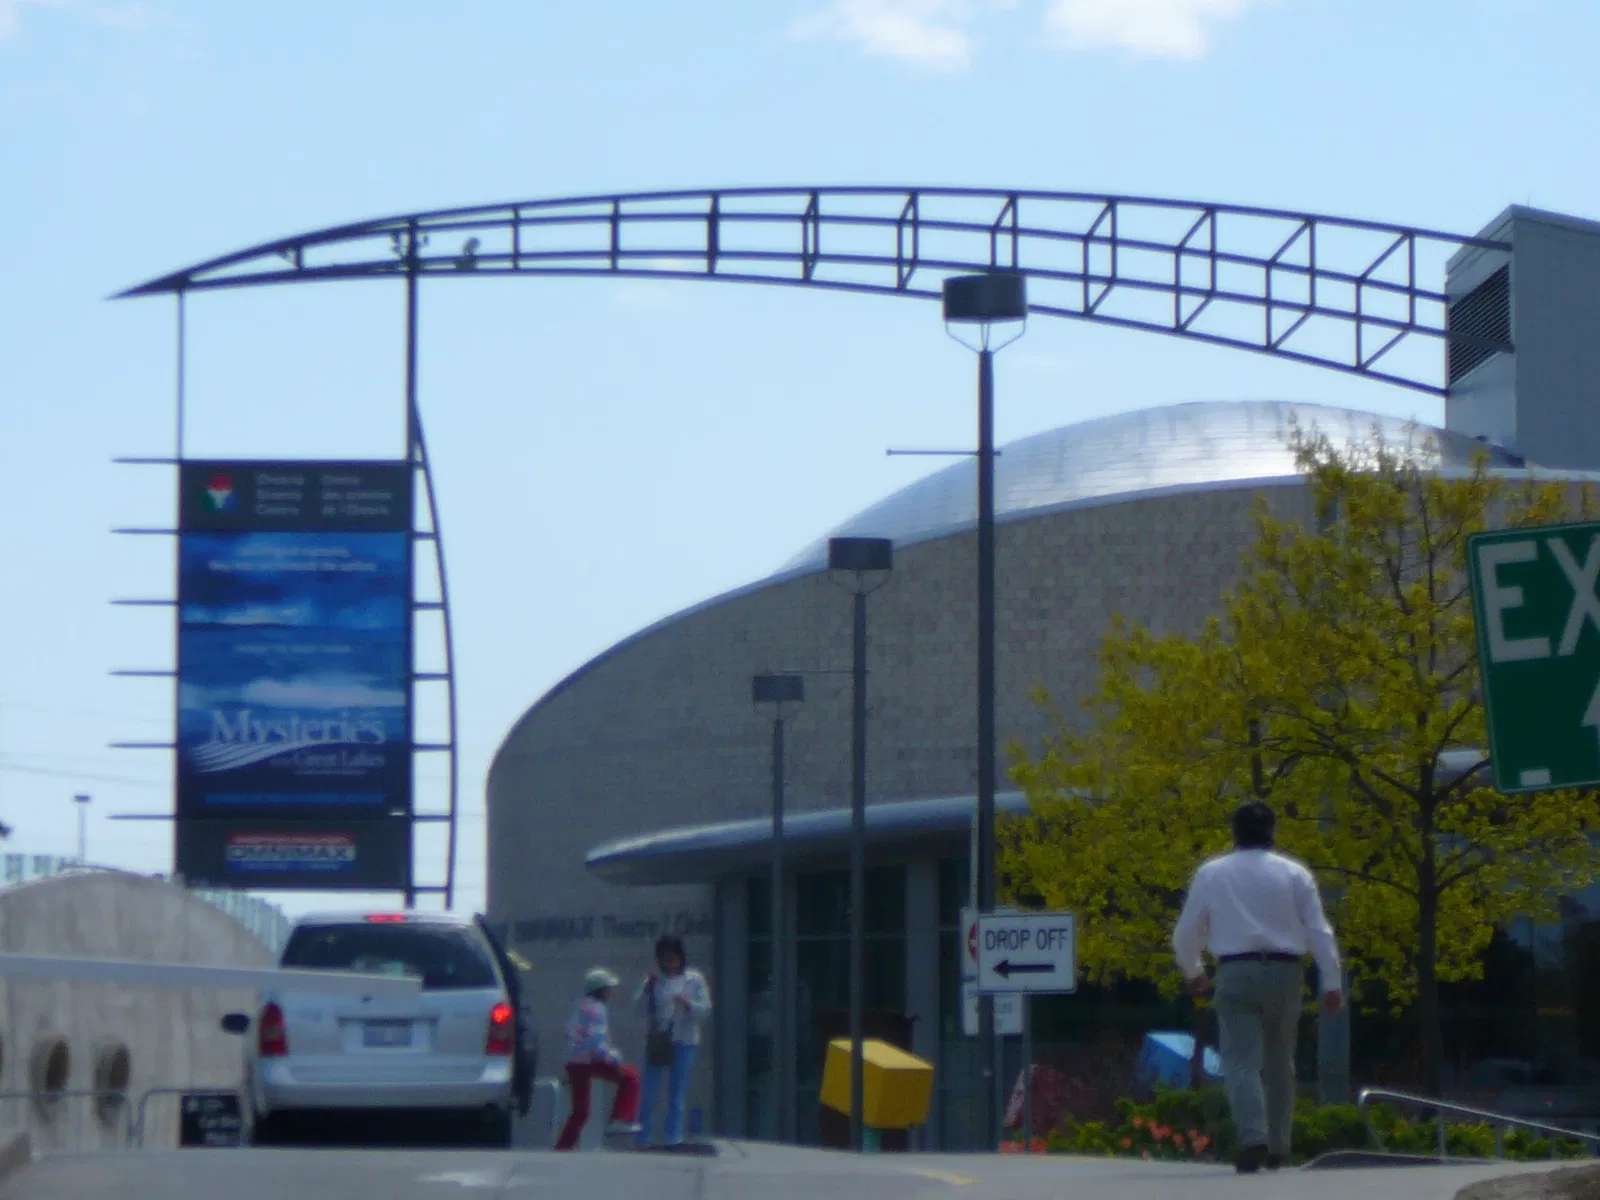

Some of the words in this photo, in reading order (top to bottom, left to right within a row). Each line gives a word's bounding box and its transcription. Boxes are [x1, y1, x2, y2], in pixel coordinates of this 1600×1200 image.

[1478, 530, 1600, 663] EX
[209, 709, 386, 745] Mysteries
[985, 929, 1030, 951] DROP
[1036, 928, 1068, 950] OFF
